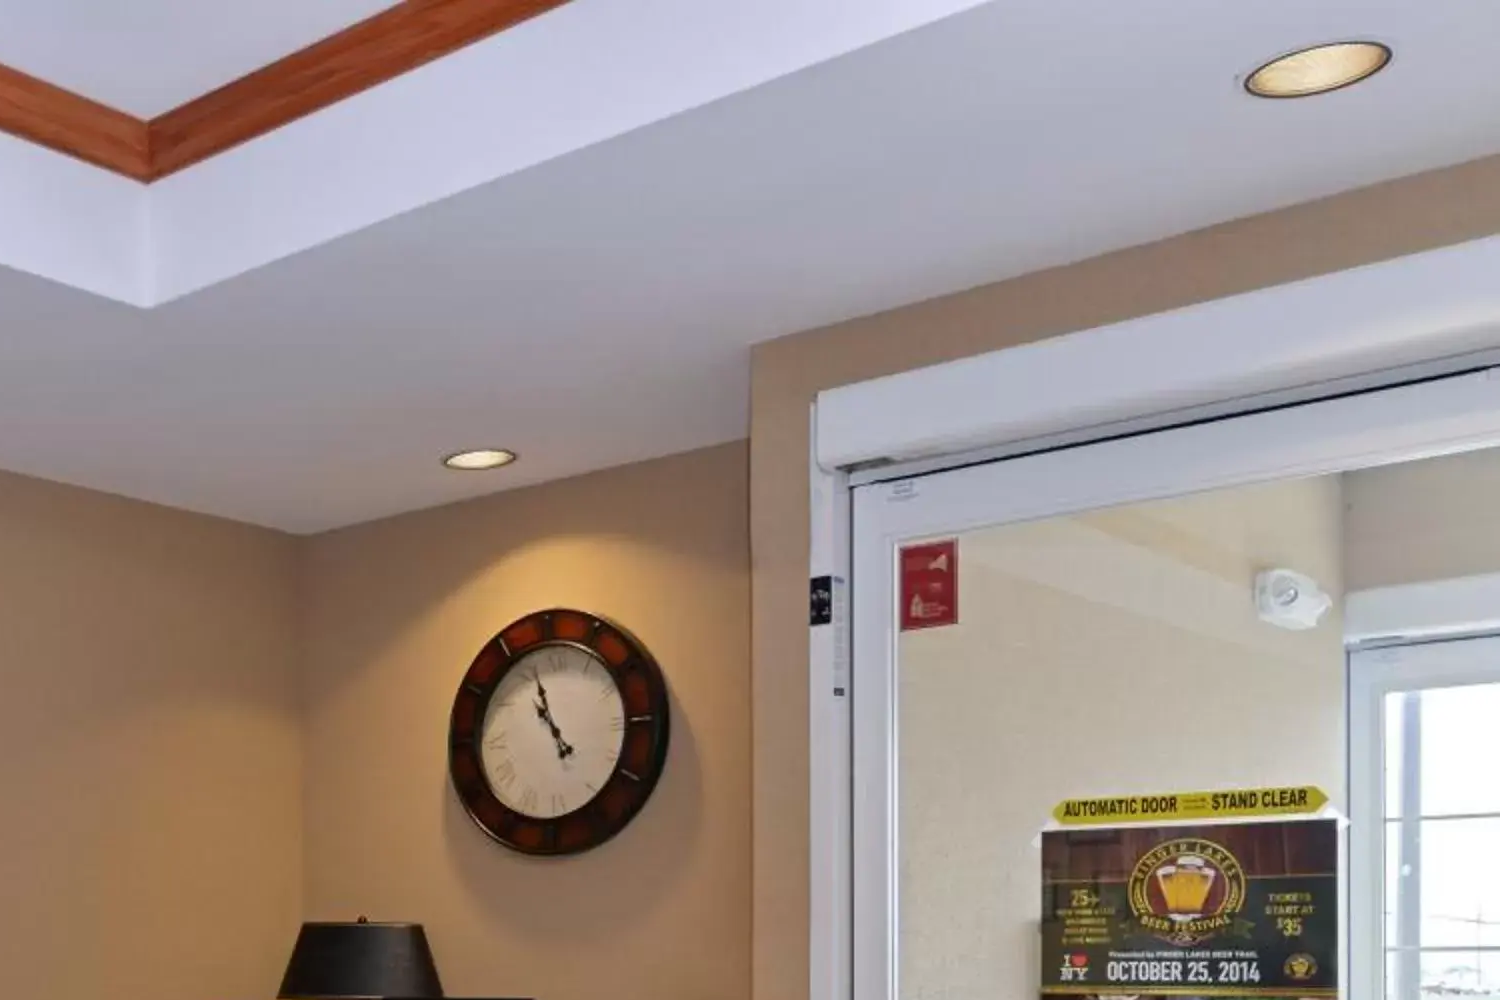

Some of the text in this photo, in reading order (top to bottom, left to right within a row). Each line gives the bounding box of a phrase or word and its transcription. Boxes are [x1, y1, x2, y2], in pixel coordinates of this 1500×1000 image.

[1063, 798, 1137, 817] AUTOMATIC
[1141, 796, 1178, 814] DOOR
[1211, 791, 1257, 811] STAND
[1261, 789, 1308, 808] CLEAR
[1140, 912, 1231, 932] BEER FESTIVAL
[1060, 967, 1088, 980] NY
[1107, 961, 1182, 982] OCTOBER
[1187, 961, 1213, 983] 25,
[1218, 961, 1260, 982] 2014
